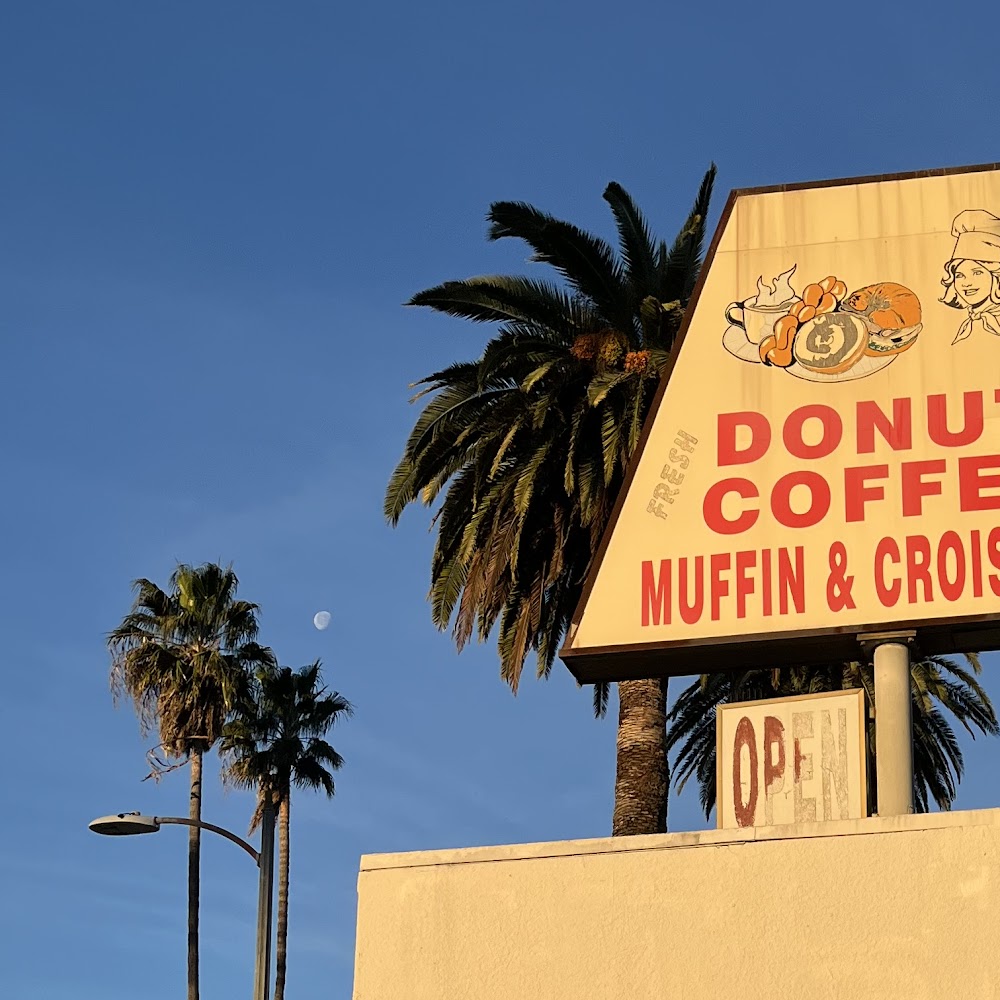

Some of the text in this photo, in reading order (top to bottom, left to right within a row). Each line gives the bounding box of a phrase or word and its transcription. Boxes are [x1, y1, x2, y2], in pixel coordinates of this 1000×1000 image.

[646, 429, 699, 520] FRESH
[641, 545, 805, 627] MUFFIN
[826, 541, 856, 613] &
[732, 707, 850, 828] OPEN
